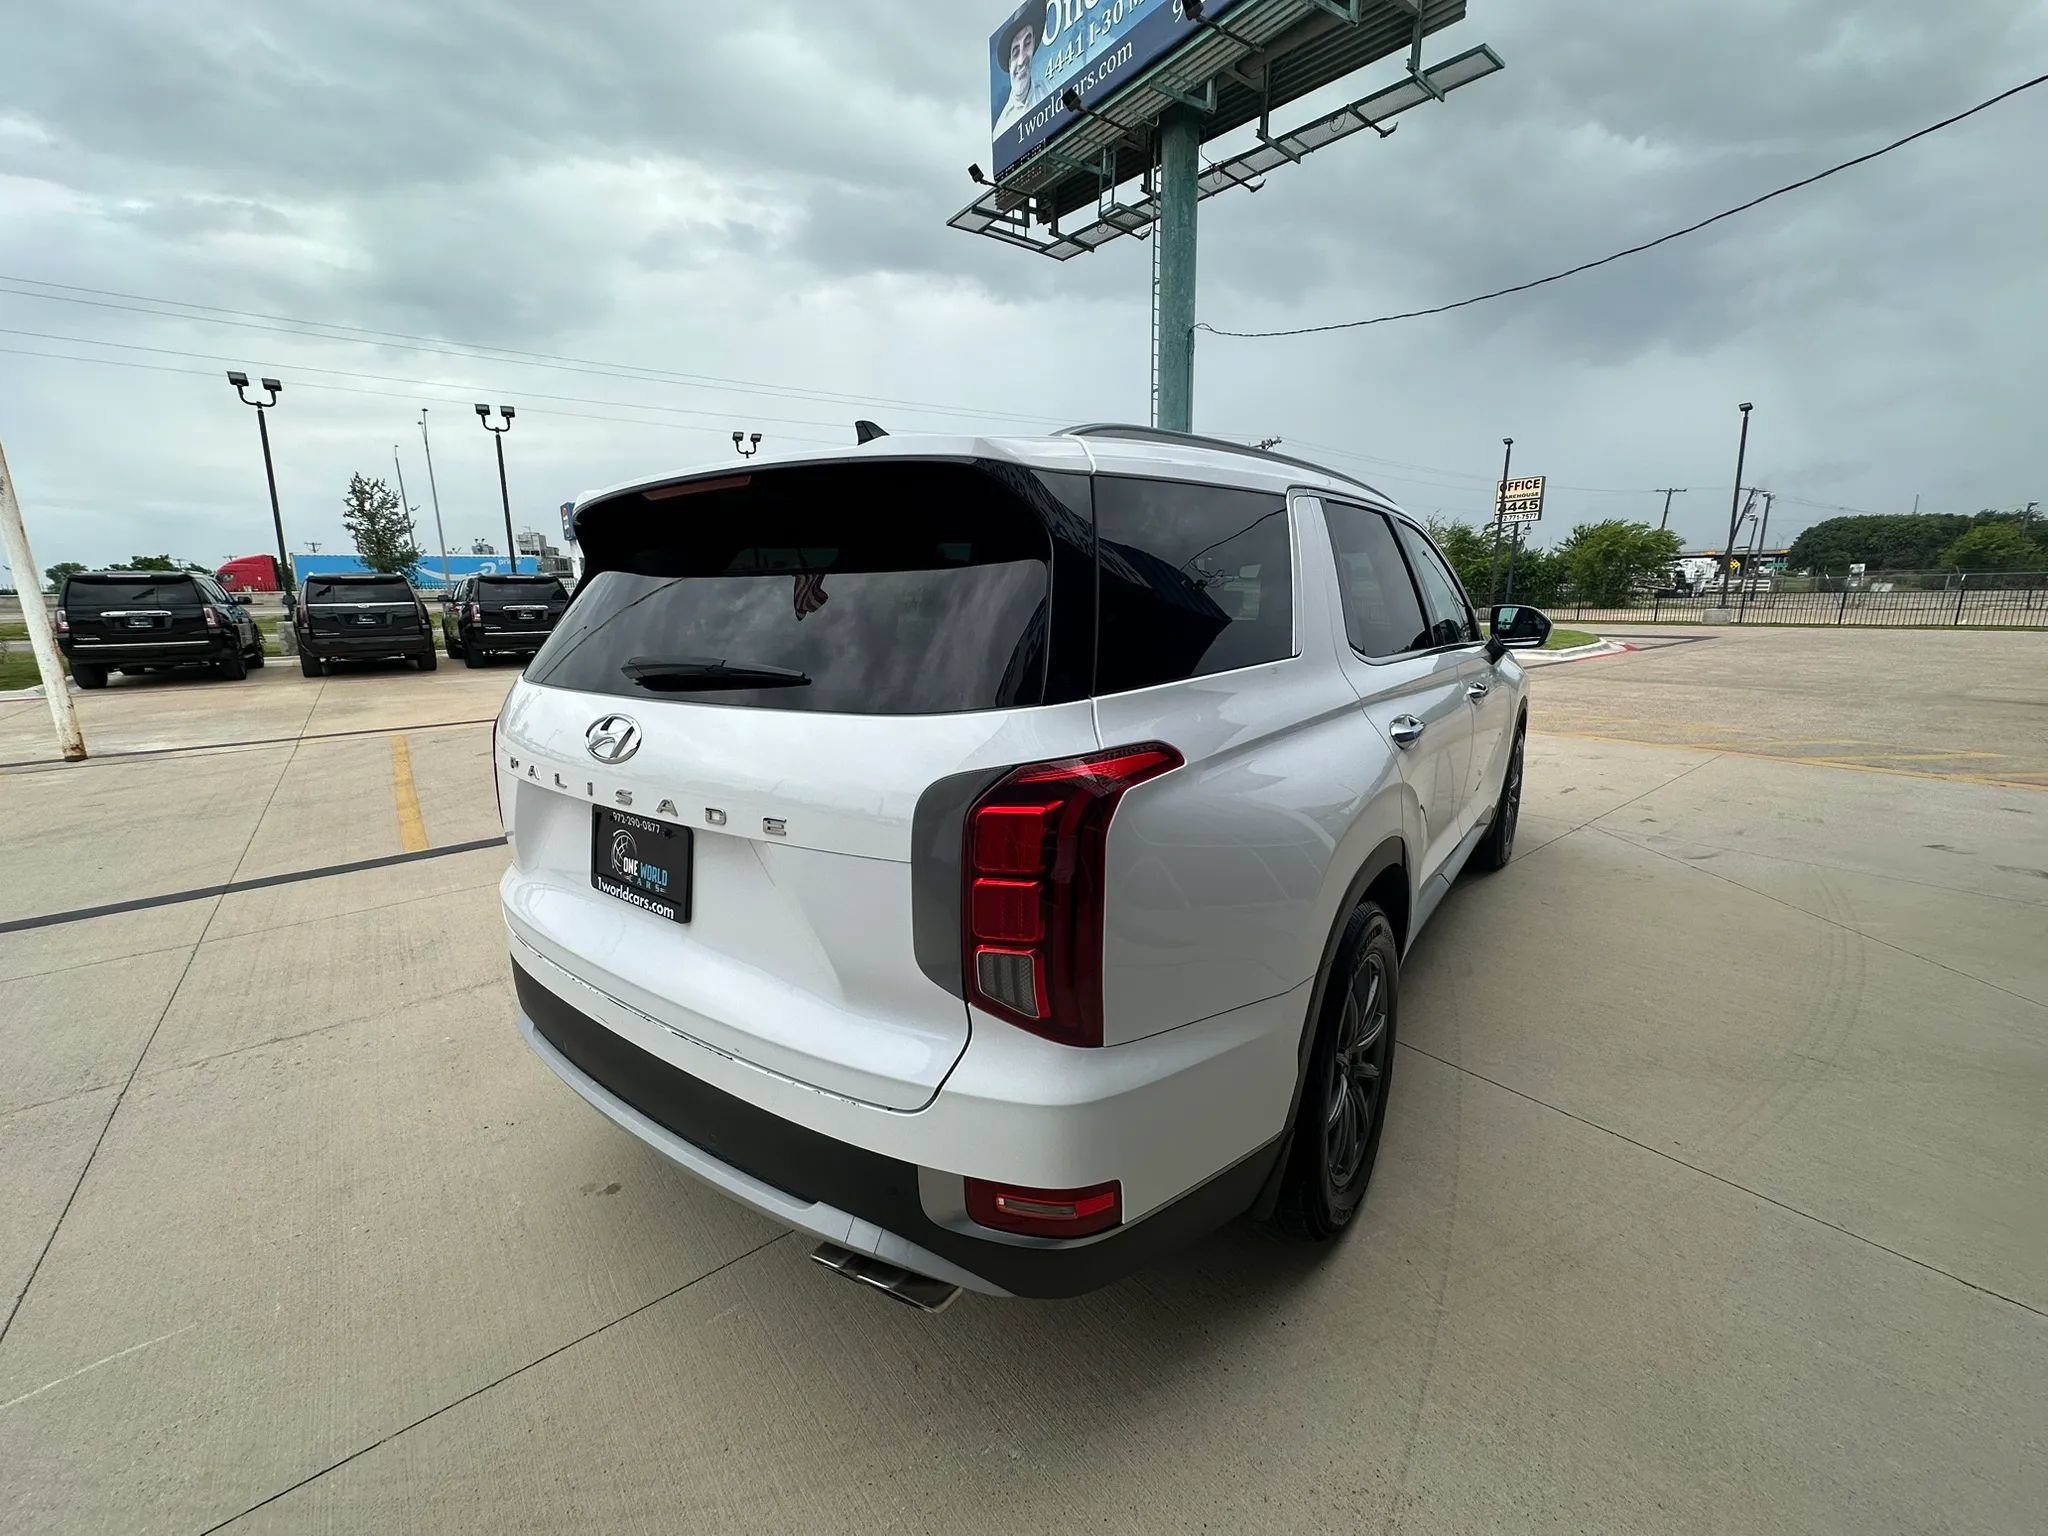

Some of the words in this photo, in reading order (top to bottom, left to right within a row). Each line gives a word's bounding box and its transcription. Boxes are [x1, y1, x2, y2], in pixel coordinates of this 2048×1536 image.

[1042, 0, 1098, 47] On
[1045, 32, 1085, 80] 4441
[1089, 0, 1124, 47] I-30
[1018, 41, 1133, 143] 1worldars.com
[510, 756, 787, 837] PALISADE
[612, 811, 661, 834] 972-290-0877
[623, 857, 639, 876] ONE
[640, 862, 668, 887] WORLD
[628, 875, 660, 893] CARS
[597, 876, 674, 920] 1worldcars.com
